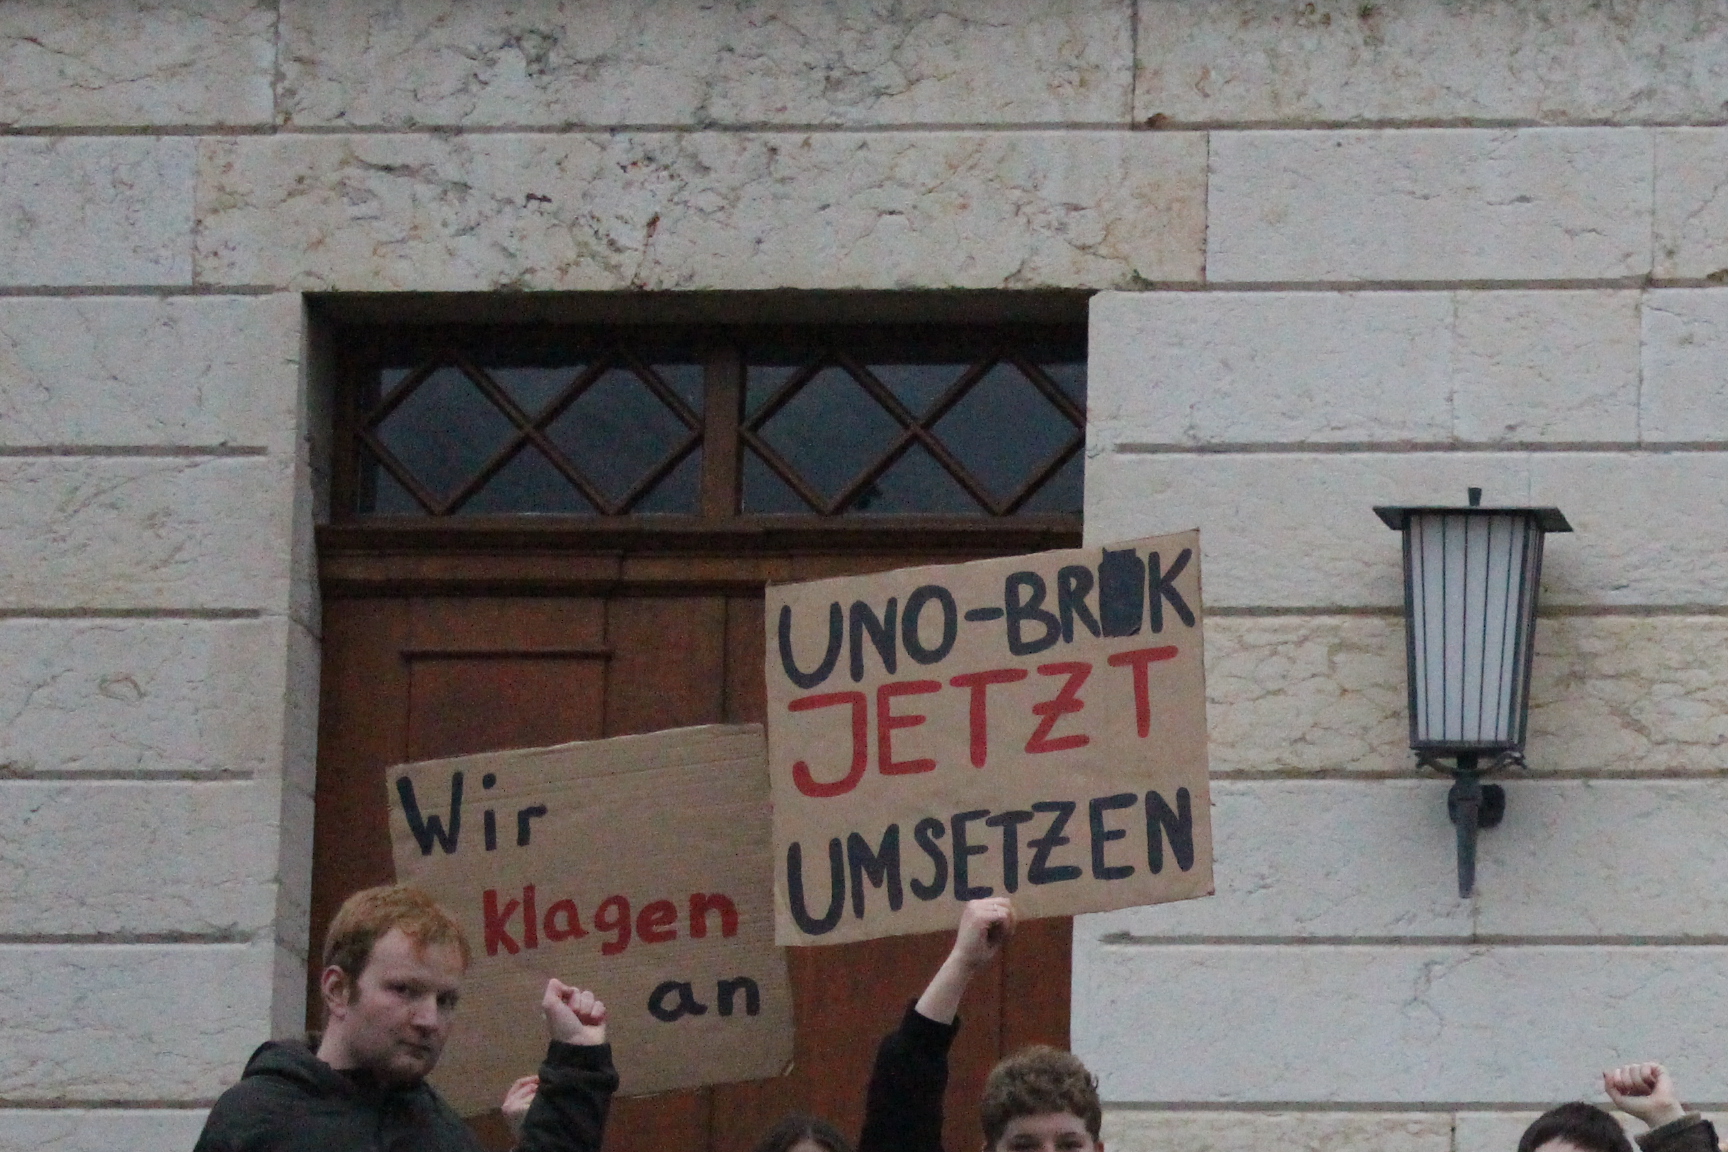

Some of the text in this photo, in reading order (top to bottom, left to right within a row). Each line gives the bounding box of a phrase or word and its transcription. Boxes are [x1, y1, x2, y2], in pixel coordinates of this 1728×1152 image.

[777, 547, 1196, 689] UNO-BRK
[788, 645, 1180, 798] JETZT
[397, 772, 548, 856] Wir
[787, 787, 1195, 936] UMSETZEN
[482, 885, 739, 957] klagen
[648, 974, 760, 1022] an
